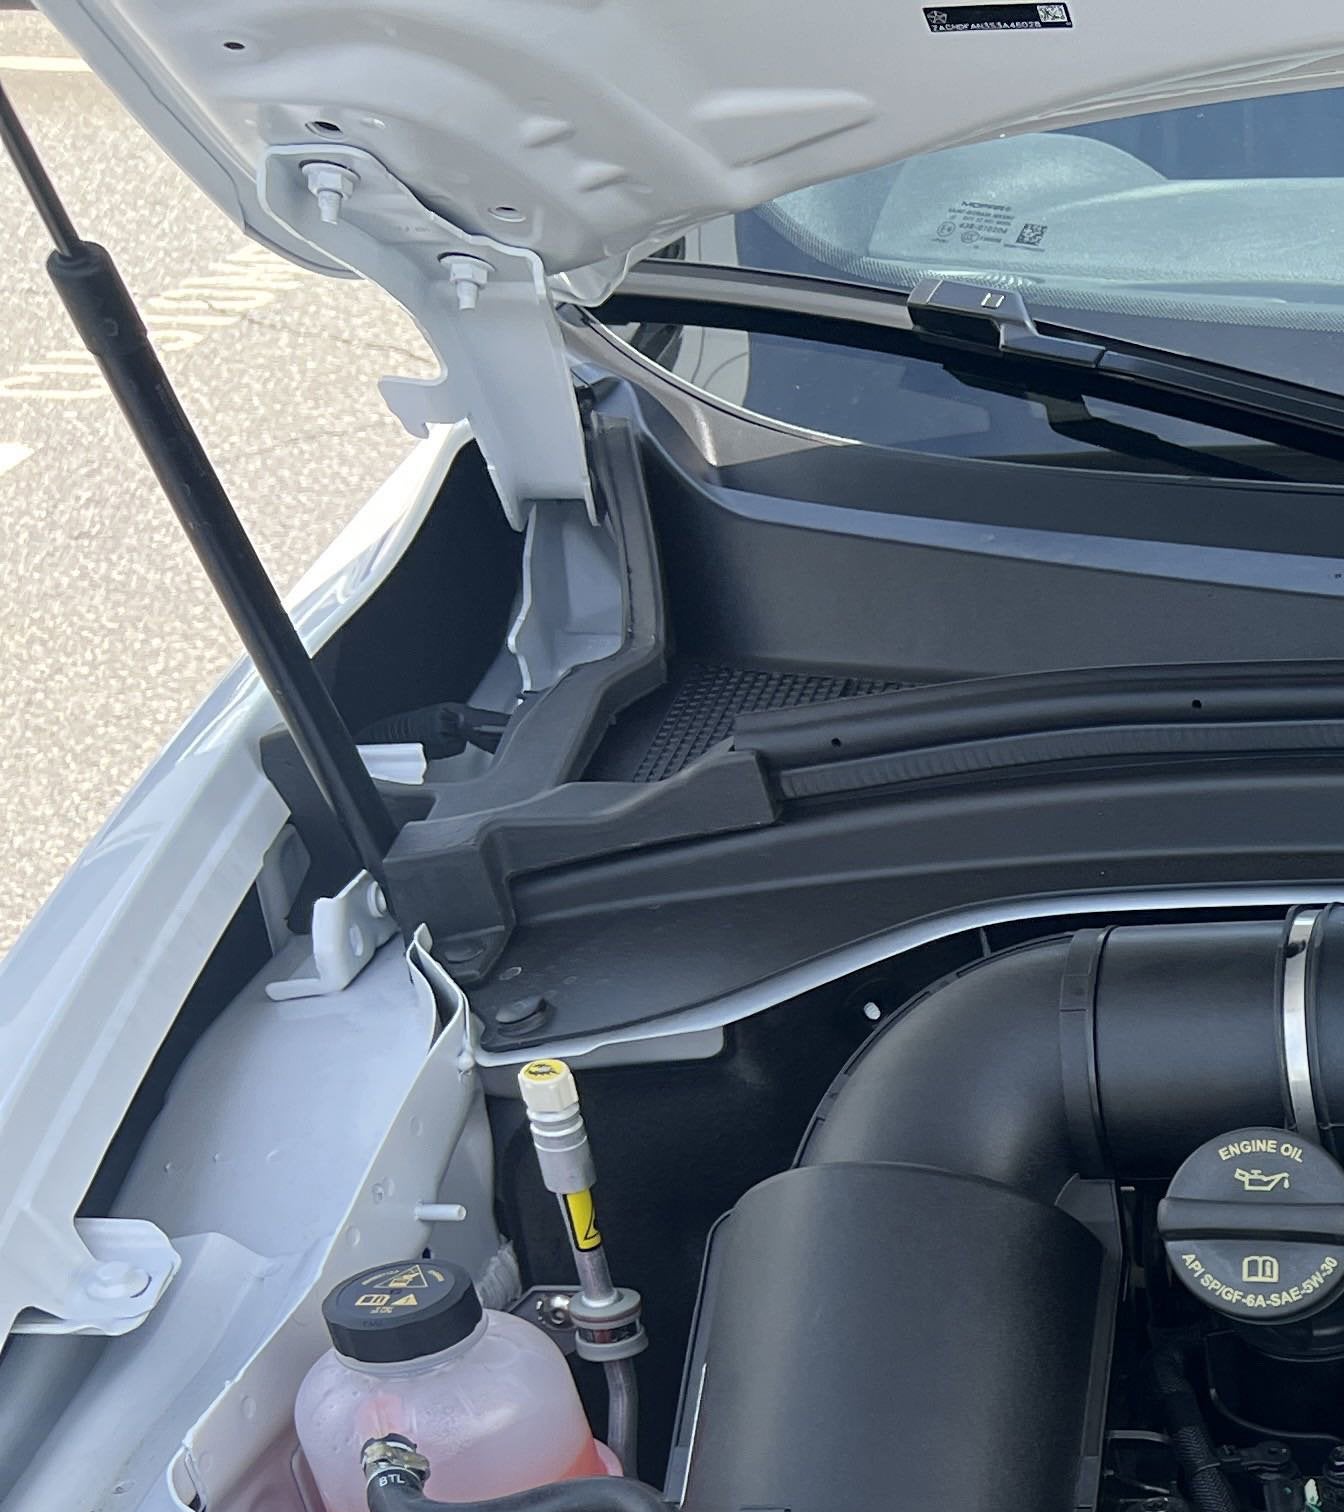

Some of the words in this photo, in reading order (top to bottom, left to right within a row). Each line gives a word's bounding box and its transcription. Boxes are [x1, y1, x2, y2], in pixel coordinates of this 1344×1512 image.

[1218, 1139, 1278, 1161] ENGINE
[1280, 1143, 1304, 1163] OIL
[1182, 1252, 1203, 1280] API
[379, 1474, 405, 1487] BTL
